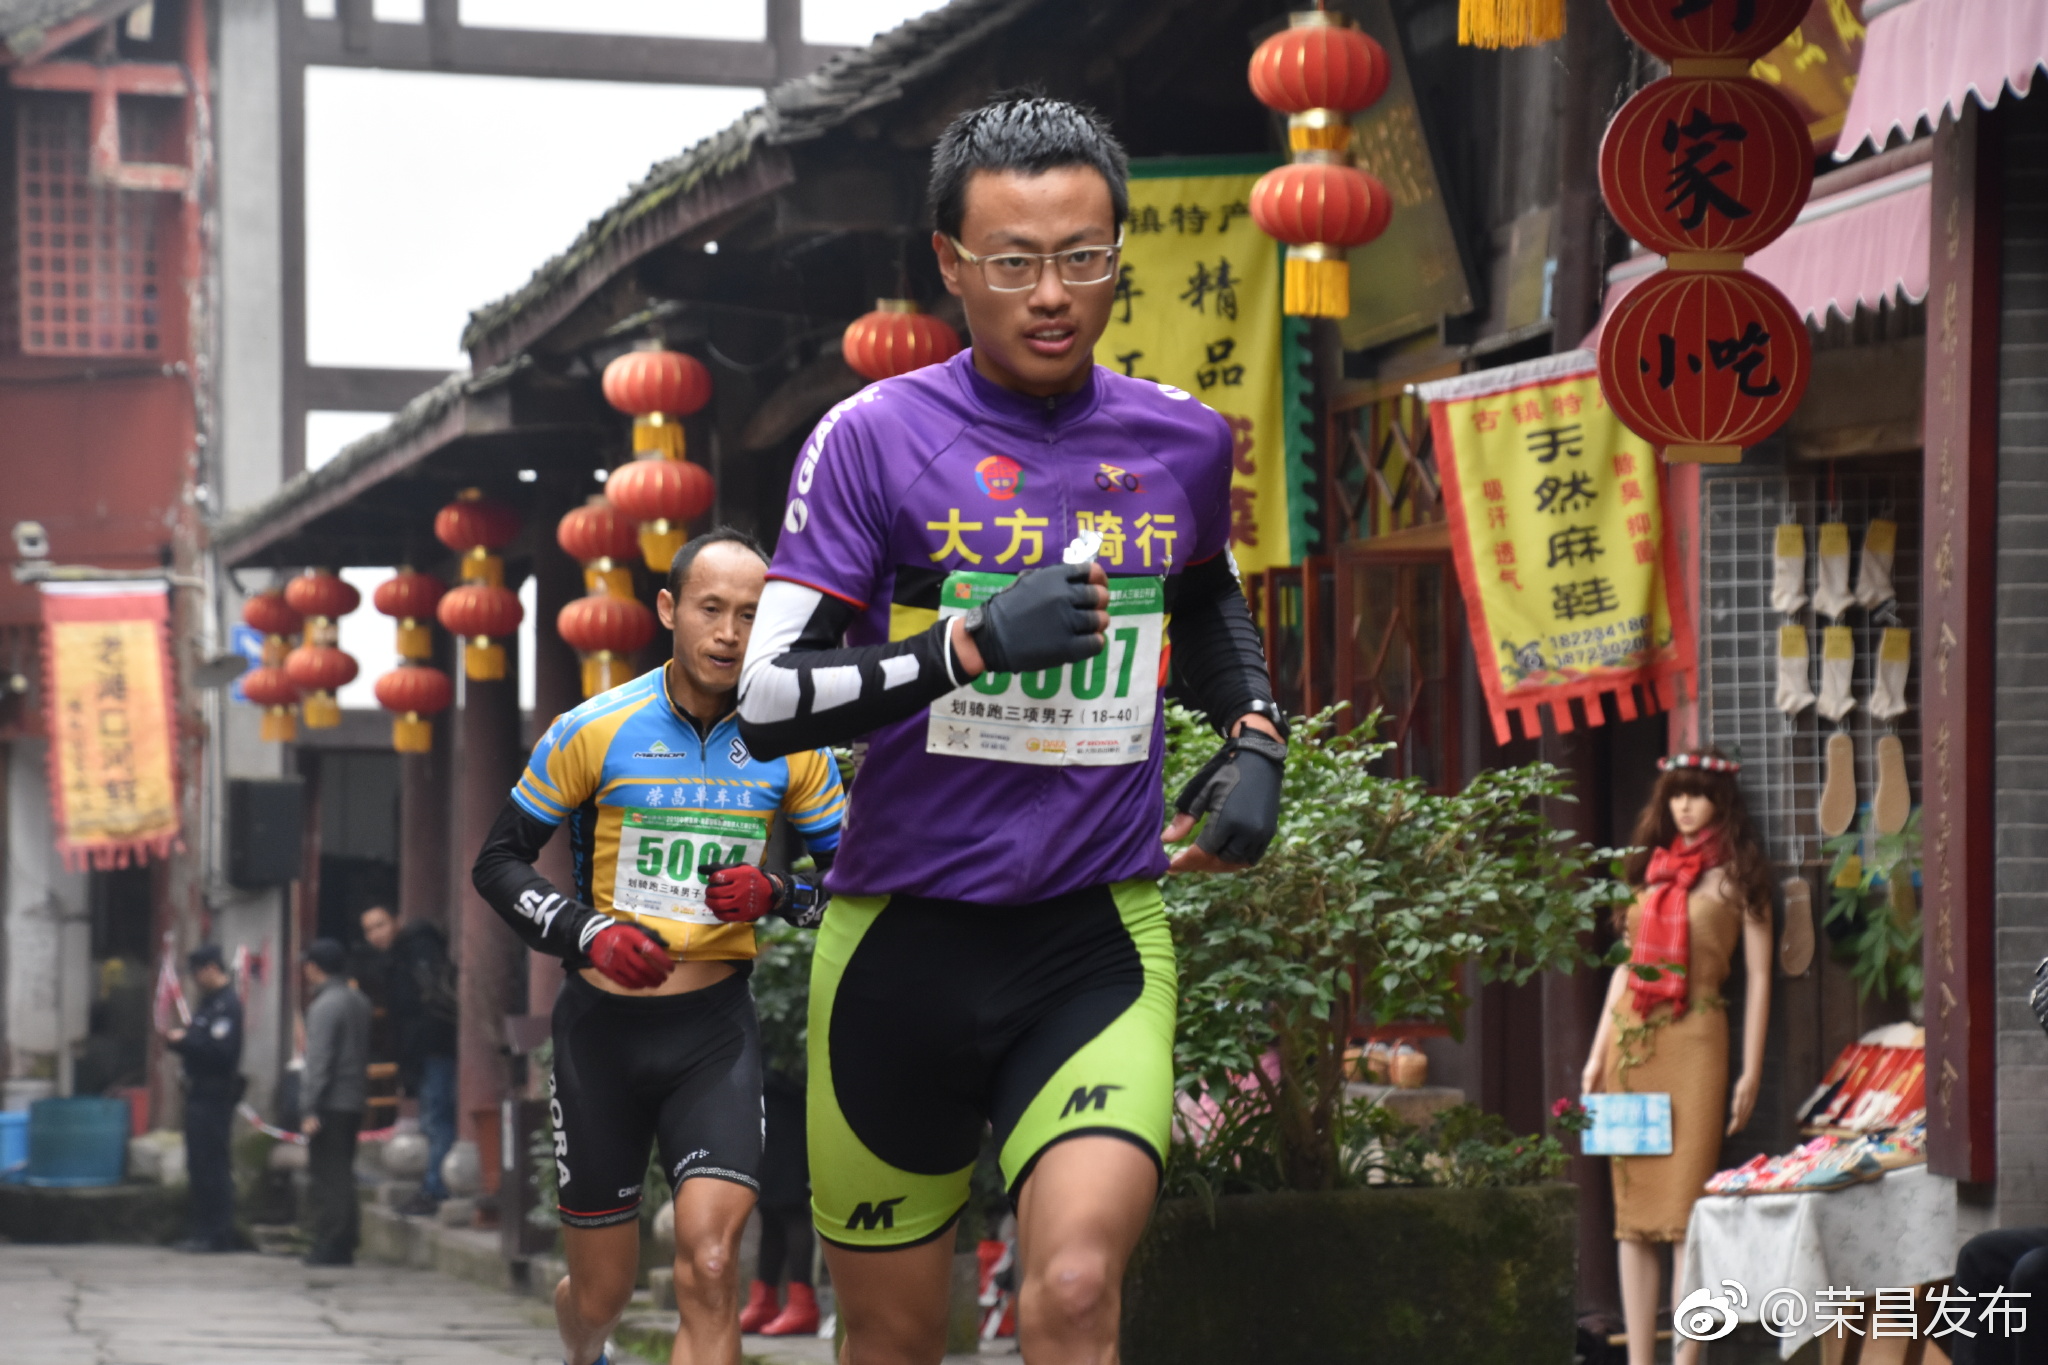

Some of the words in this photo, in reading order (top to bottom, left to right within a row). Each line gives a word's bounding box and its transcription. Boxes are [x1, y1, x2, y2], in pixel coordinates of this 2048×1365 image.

[1662, 108, 1752, 230] 家
[1639, 321, 1781, 397] 小吃
[1471, 390, 1604, 433] 古镇特
